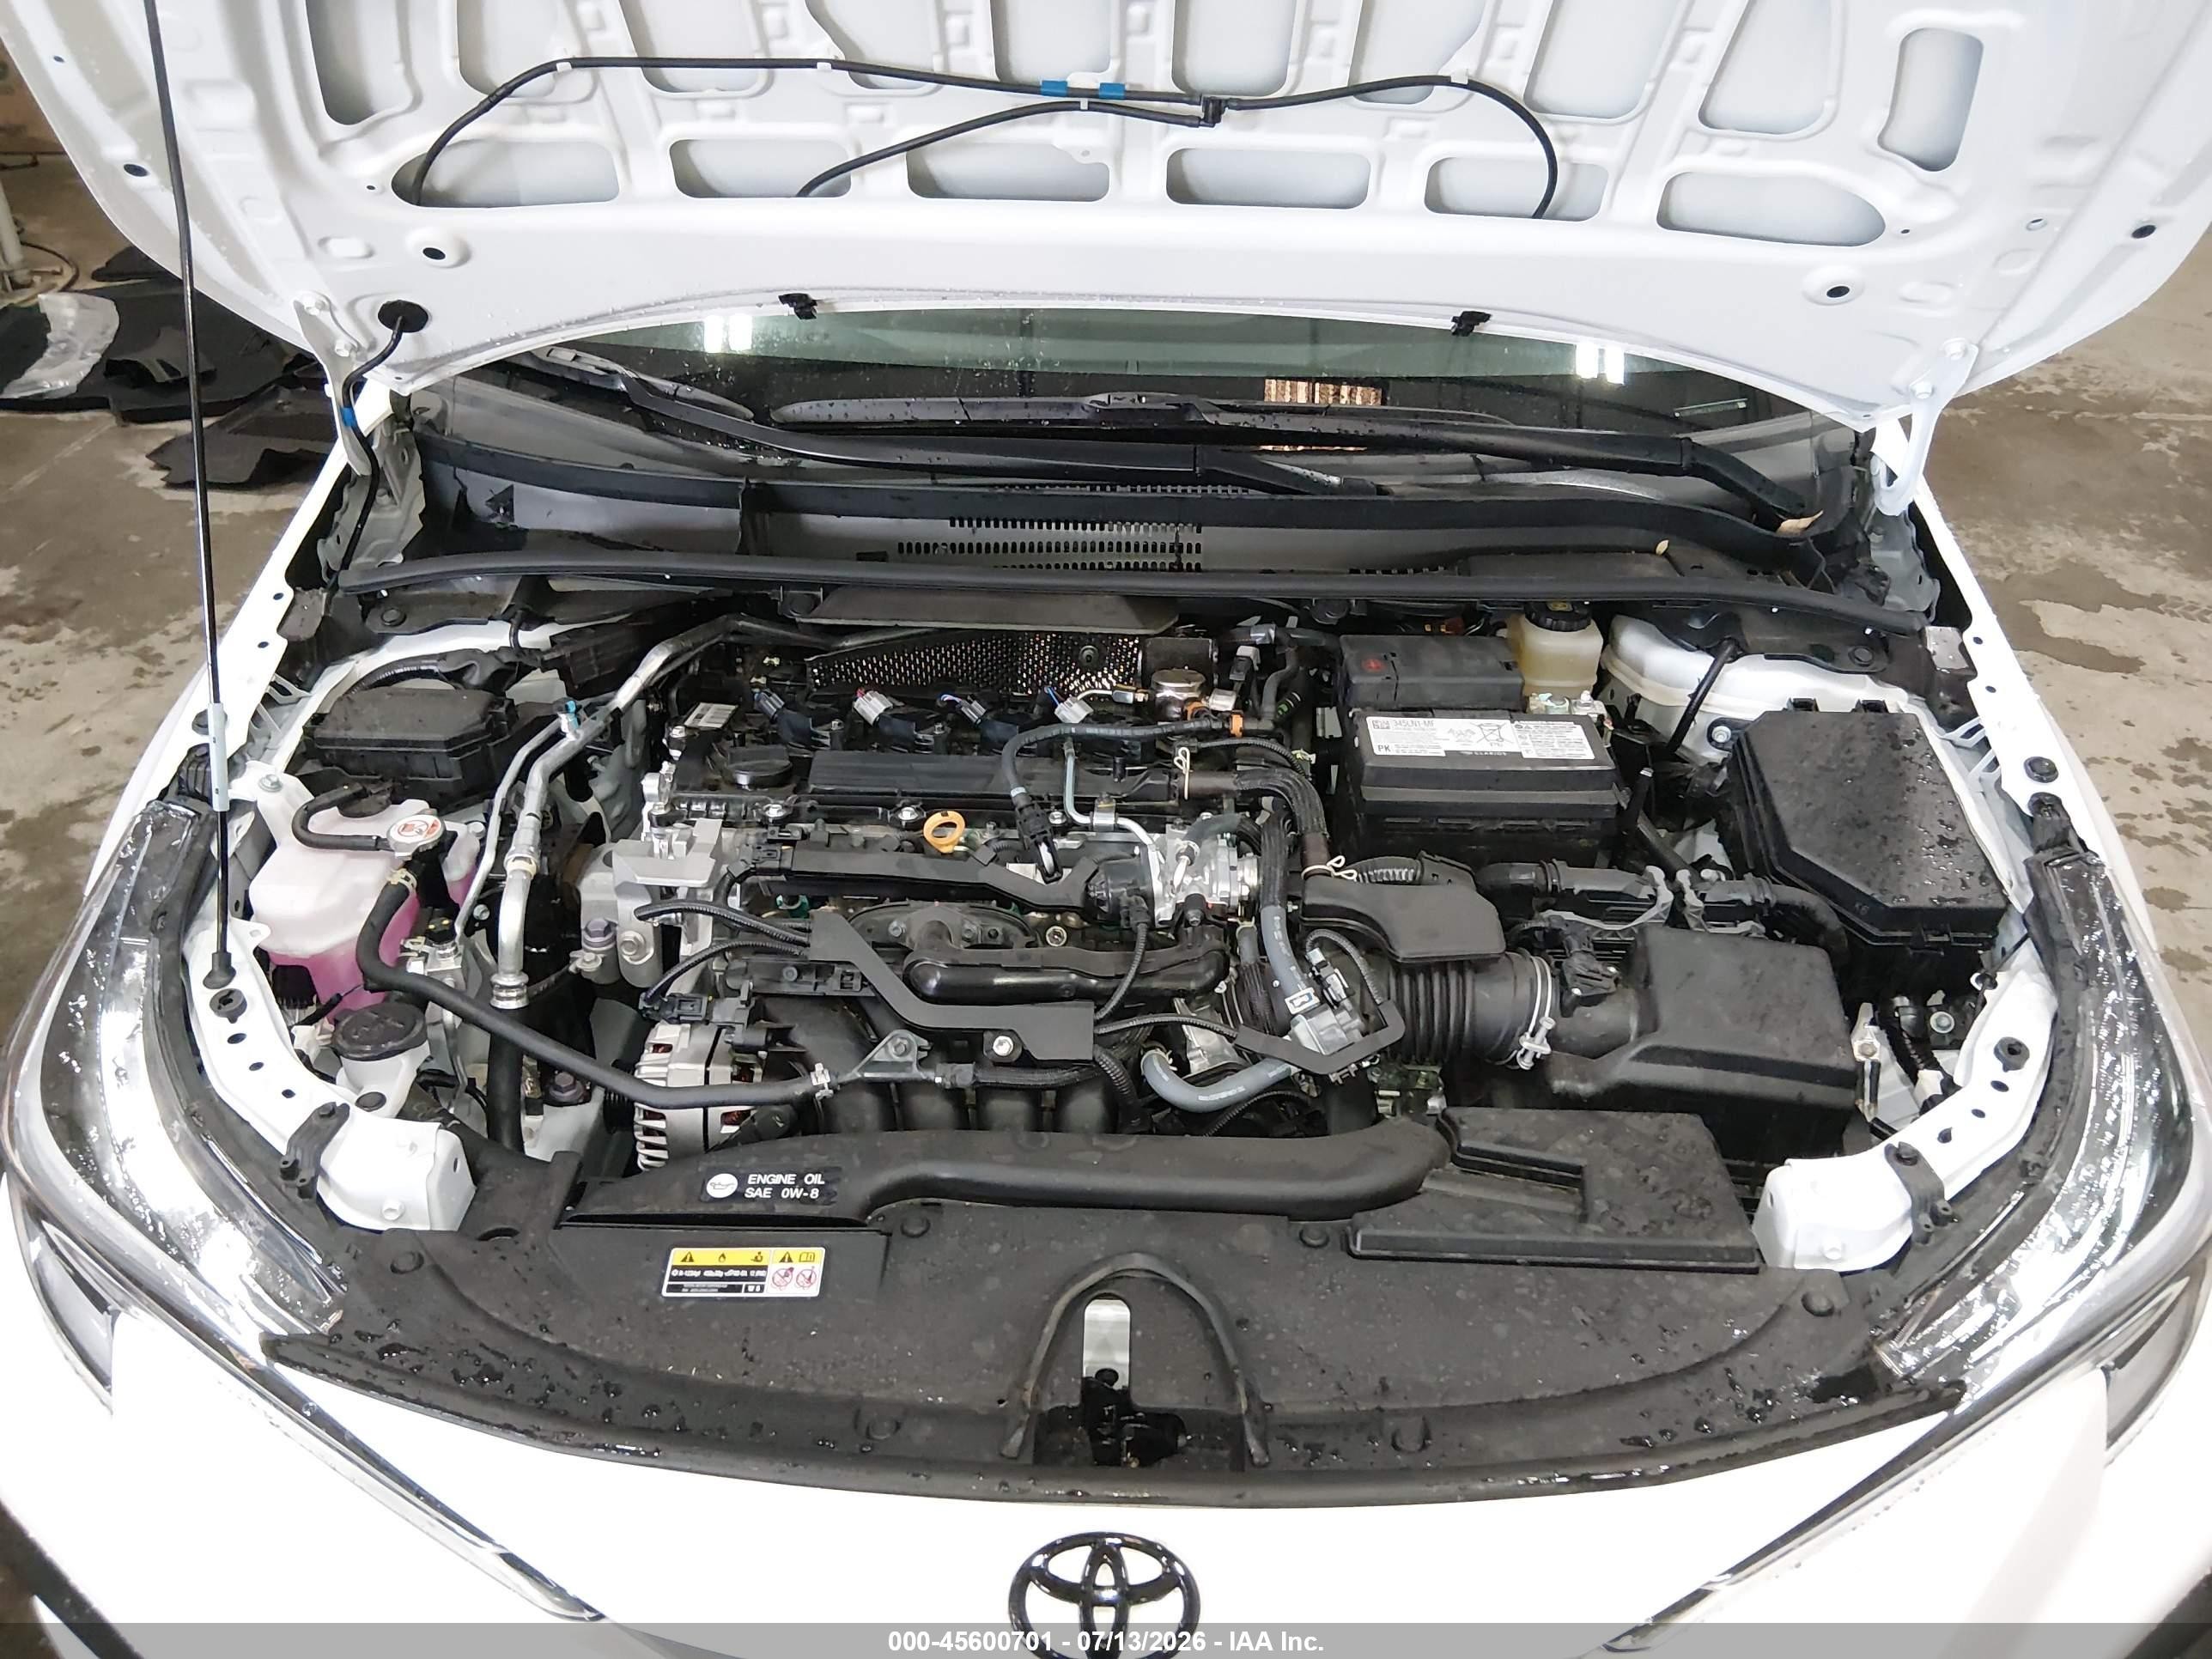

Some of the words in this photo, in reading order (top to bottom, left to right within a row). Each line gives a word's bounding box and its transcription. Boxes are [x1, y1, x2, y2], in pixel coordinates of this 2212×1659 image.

[748, 1174, 796, 1185] ENGINE
[804, 1174, 825, 1185] OIL
[744, 1188, 772, 1199] SAE
[781, 1188, 819, 1199] 0W-8
